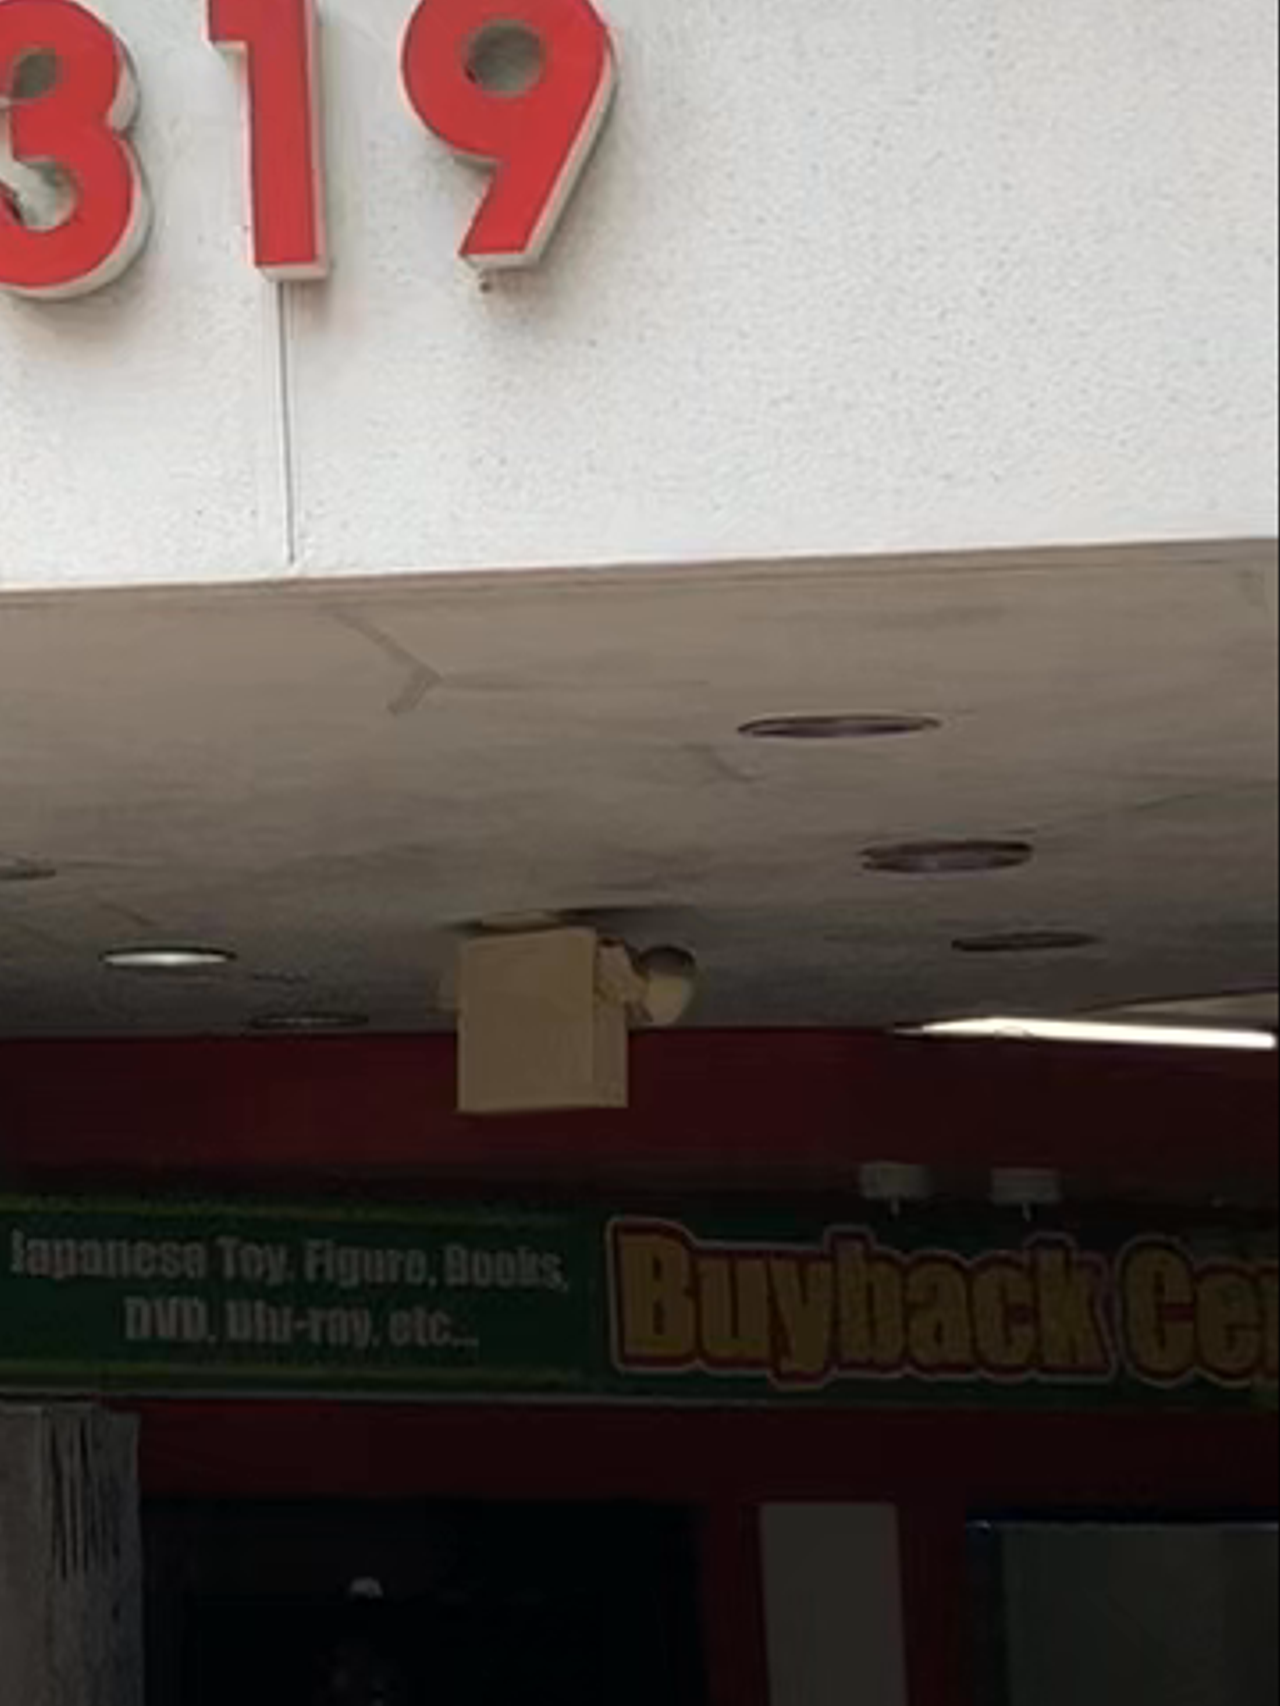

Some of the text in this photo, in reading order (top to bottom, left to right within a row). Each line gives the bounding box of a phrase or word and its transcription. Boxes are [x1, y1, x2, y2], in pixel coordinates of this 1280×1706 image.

[10, 1228, 208, 1282] Japanese
[445, 1243, 570, 1294] Books,
[612, 1223, 1105, 1381] Buyback
